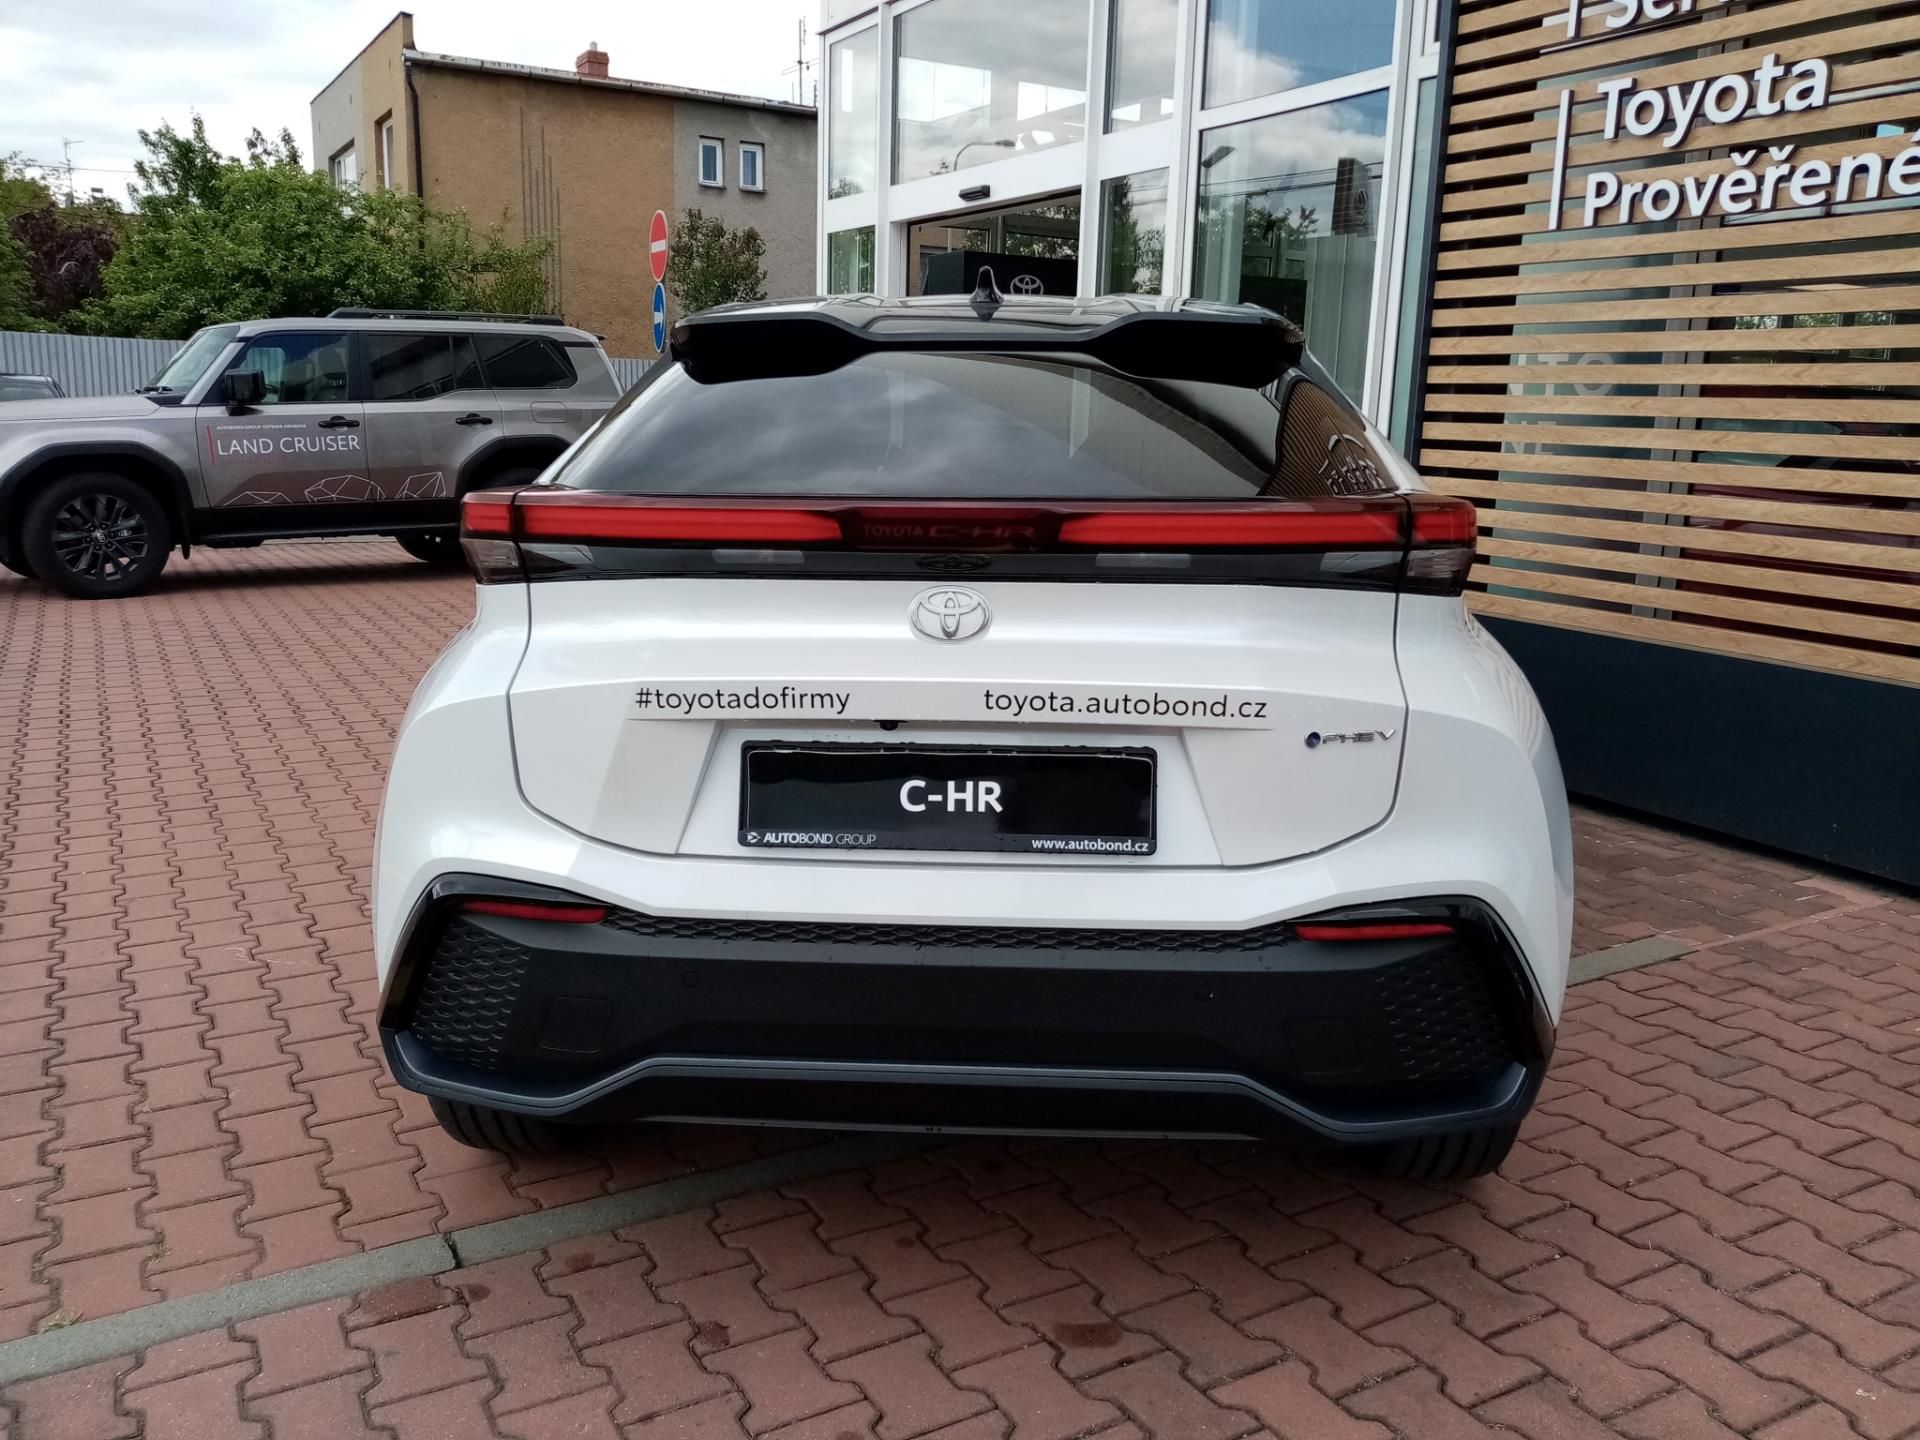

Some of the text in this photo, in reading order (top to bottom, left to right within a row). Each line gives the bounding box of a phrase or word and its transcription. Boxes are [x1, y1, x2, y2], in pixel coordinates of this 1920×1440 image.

[1597, 53, 1831, 148] Toyota
[1583, 128, 1920, 227] Prověřené
[217, 435, 361, 455] LAND CRUISER
[863, 525, 1035, 537] TOYOTA C-HR
[636, 686, 850, 715] #toyotadofirmy
[984, 689, 1268, 719] toyota.autobond.cz
[1322, 729, 1396, 745] PHEV
[899, 779, 1004, 813] C-HR
[763, 832, 877, 845] AUTOBOND GROUP
[1031, 838, 1149, 852] www.autobond.cz
